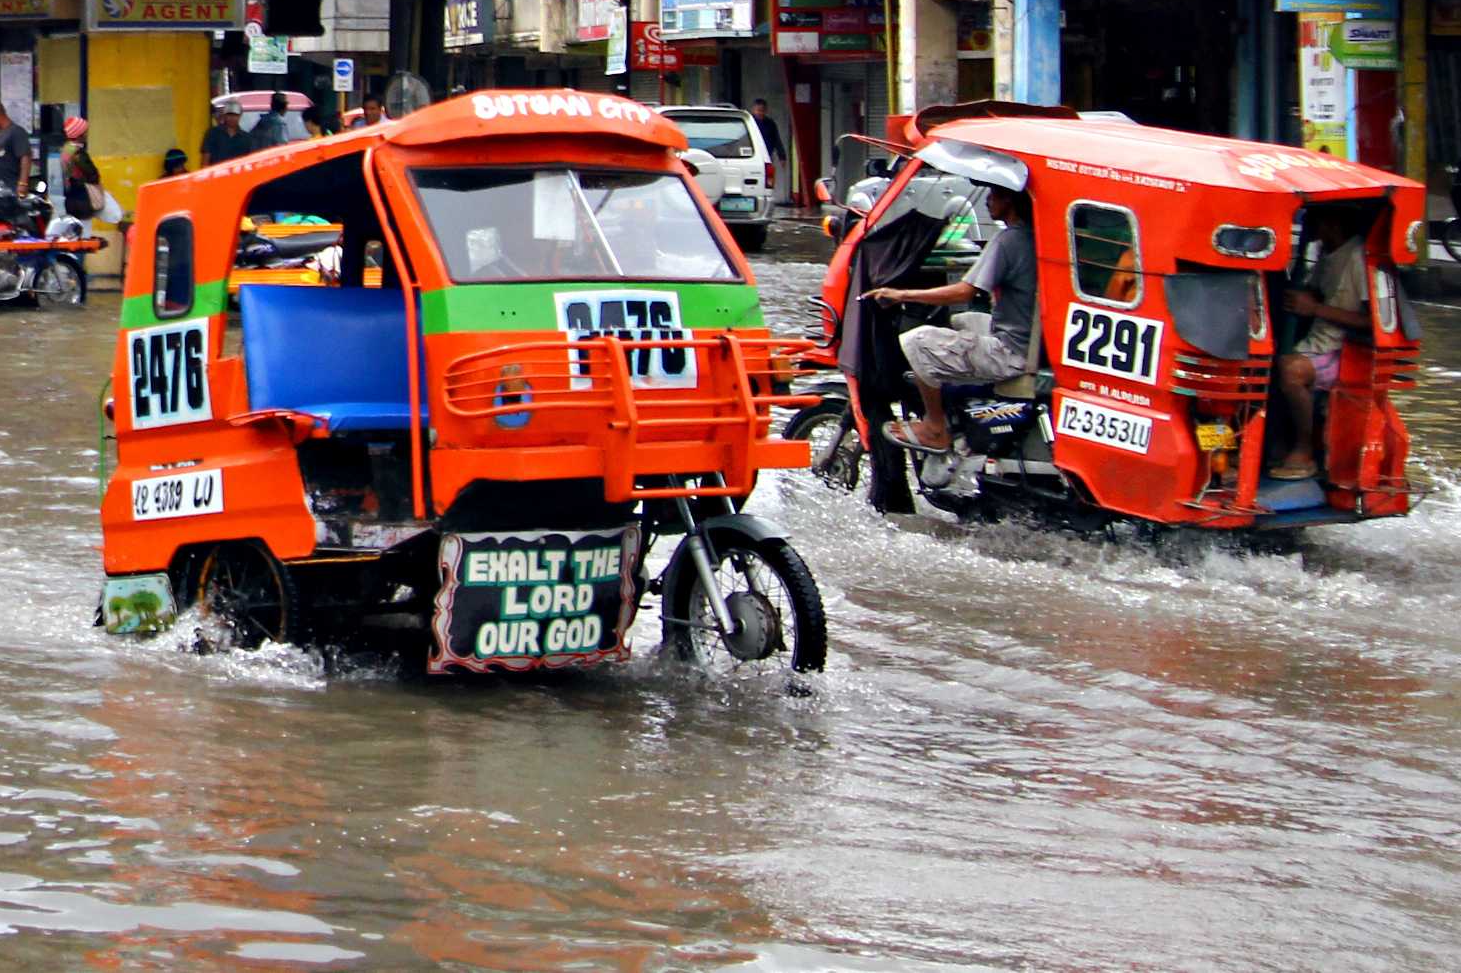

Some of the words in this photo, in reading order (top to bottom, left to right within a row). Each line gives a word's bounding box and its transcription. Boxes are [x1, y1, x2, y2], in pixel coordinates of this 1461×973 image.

[142, 5, 231, 20] AGENT
[1067, 309, 1157, 378] 2291
[132, 328, 205, 419] 2476
[1062, 404, 1152, 448] 12-3353LU
[466, 548, 568, 585] EXALT
[573, 547, 621, 581] THE
[503, 583, 594, 617] LORD
[478, 620, 540, 656] OUR
[545, 613, 602, 652] GOD
